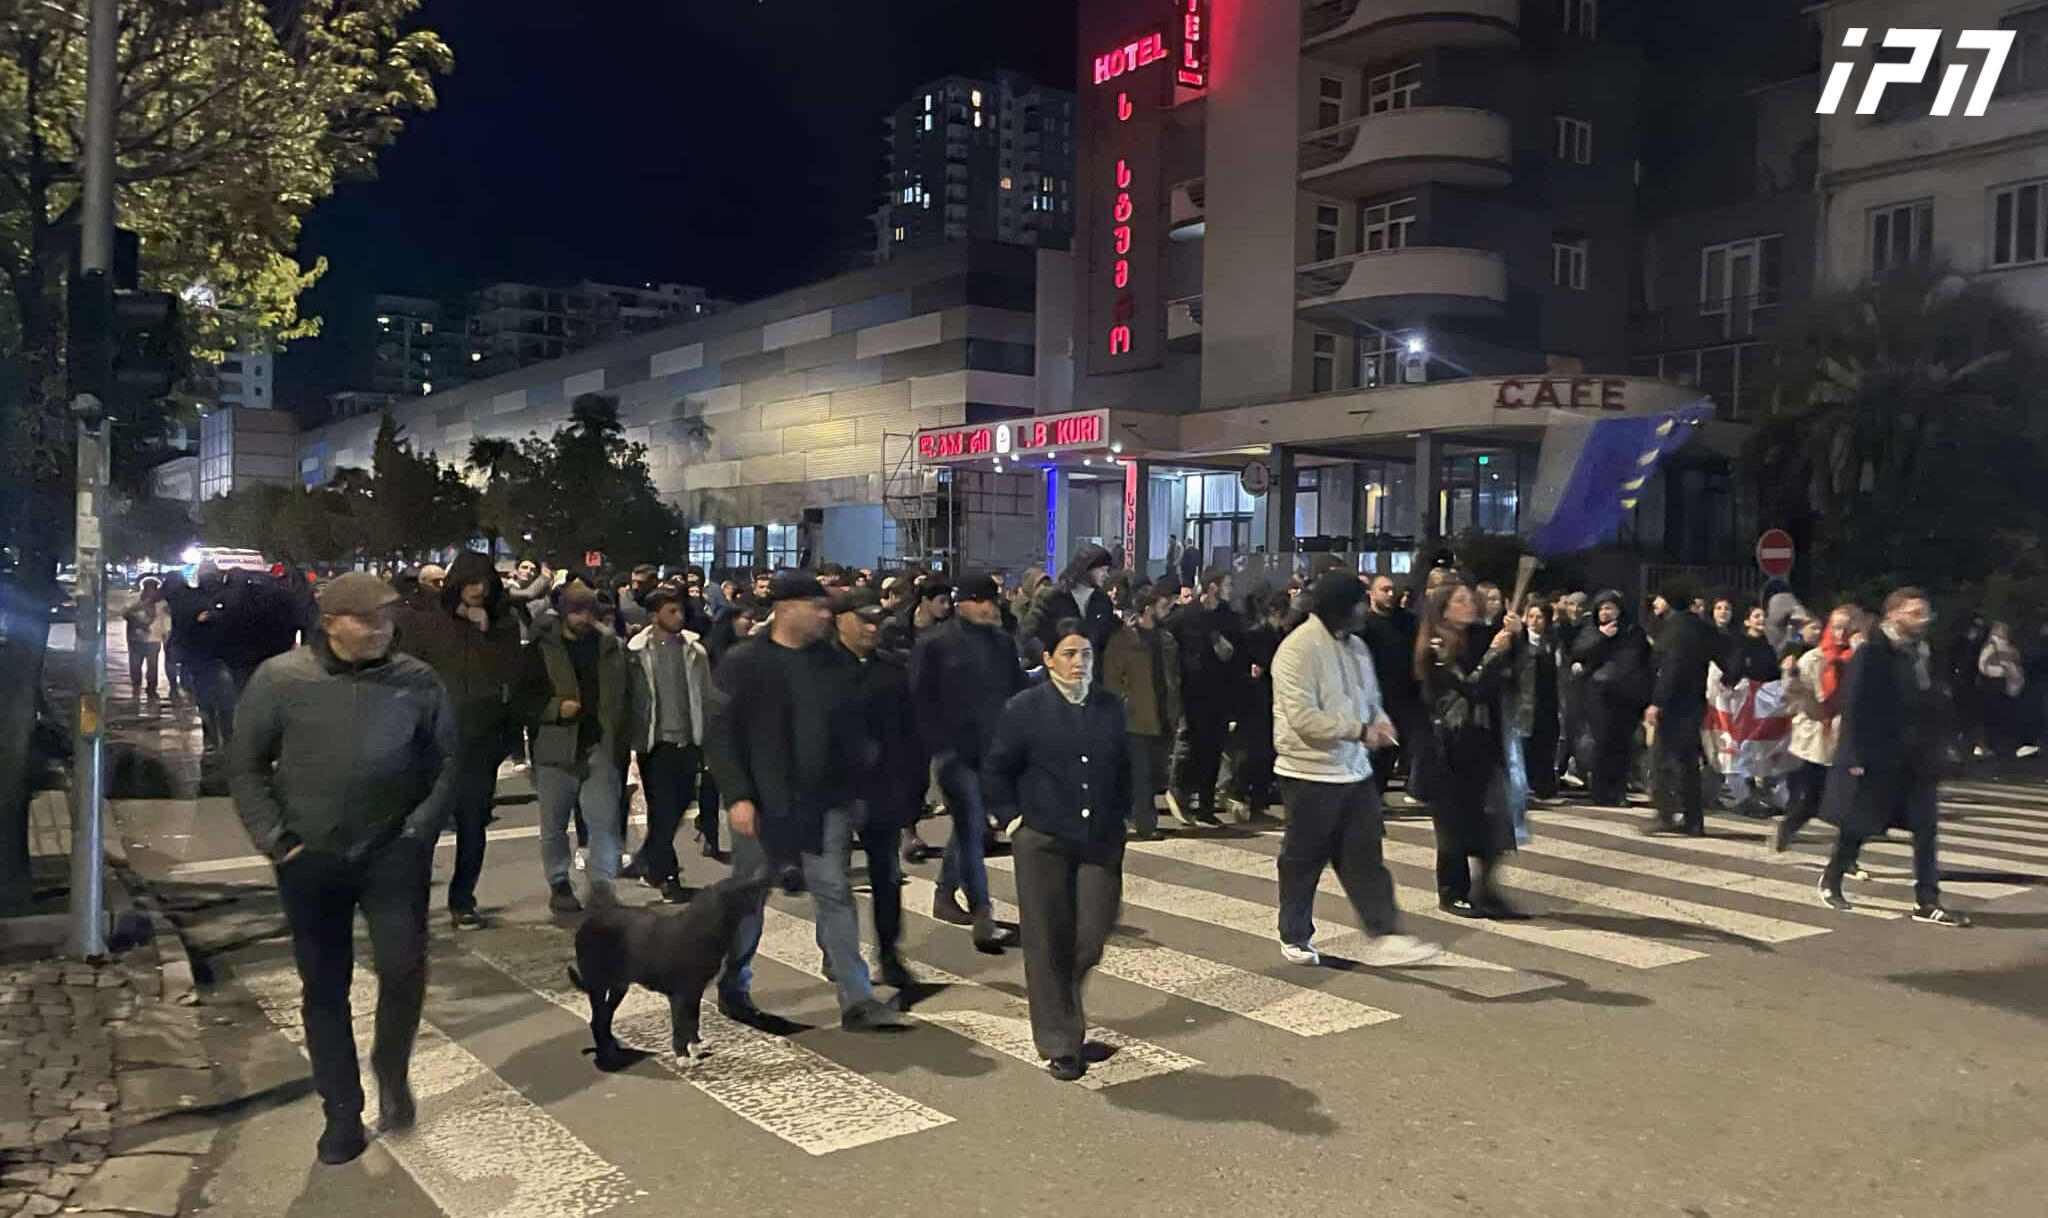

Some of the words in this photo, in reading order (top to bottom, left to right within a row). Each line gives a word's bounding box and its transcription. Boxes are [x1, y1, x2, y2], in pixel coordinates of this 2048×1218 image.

[1093, 33, 1168, 84] HOTEL
[1109, 92, 1133, 356] სსტუმო
[1497, 379, 1626, 411] CAFE
